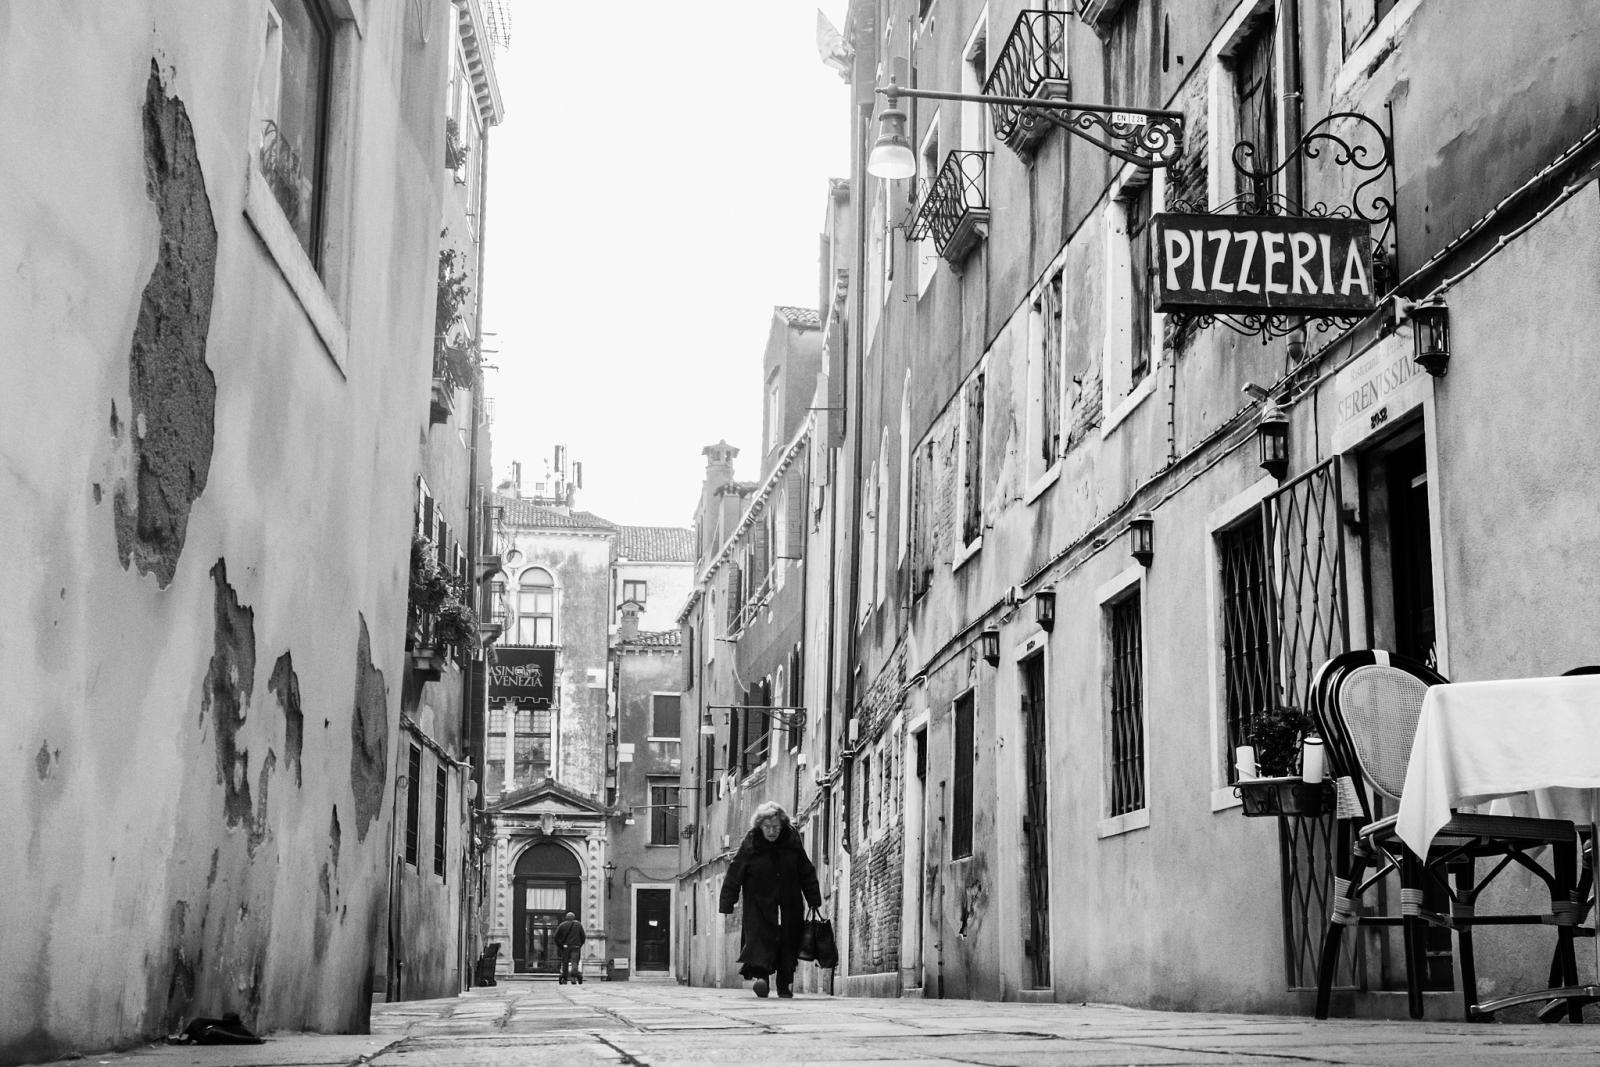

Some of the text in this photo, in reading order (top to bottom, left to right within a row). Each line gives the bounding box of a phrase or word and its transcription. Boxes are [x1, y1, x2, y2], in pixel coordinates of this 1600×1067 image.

[1164, 229, 1369, 296] PIZZERIA
[1338, 356, 1421, 423] SERENISSIM
[489, 665, 526, 677] ASINO
[494, 675, 543, 687] VENEZIA
